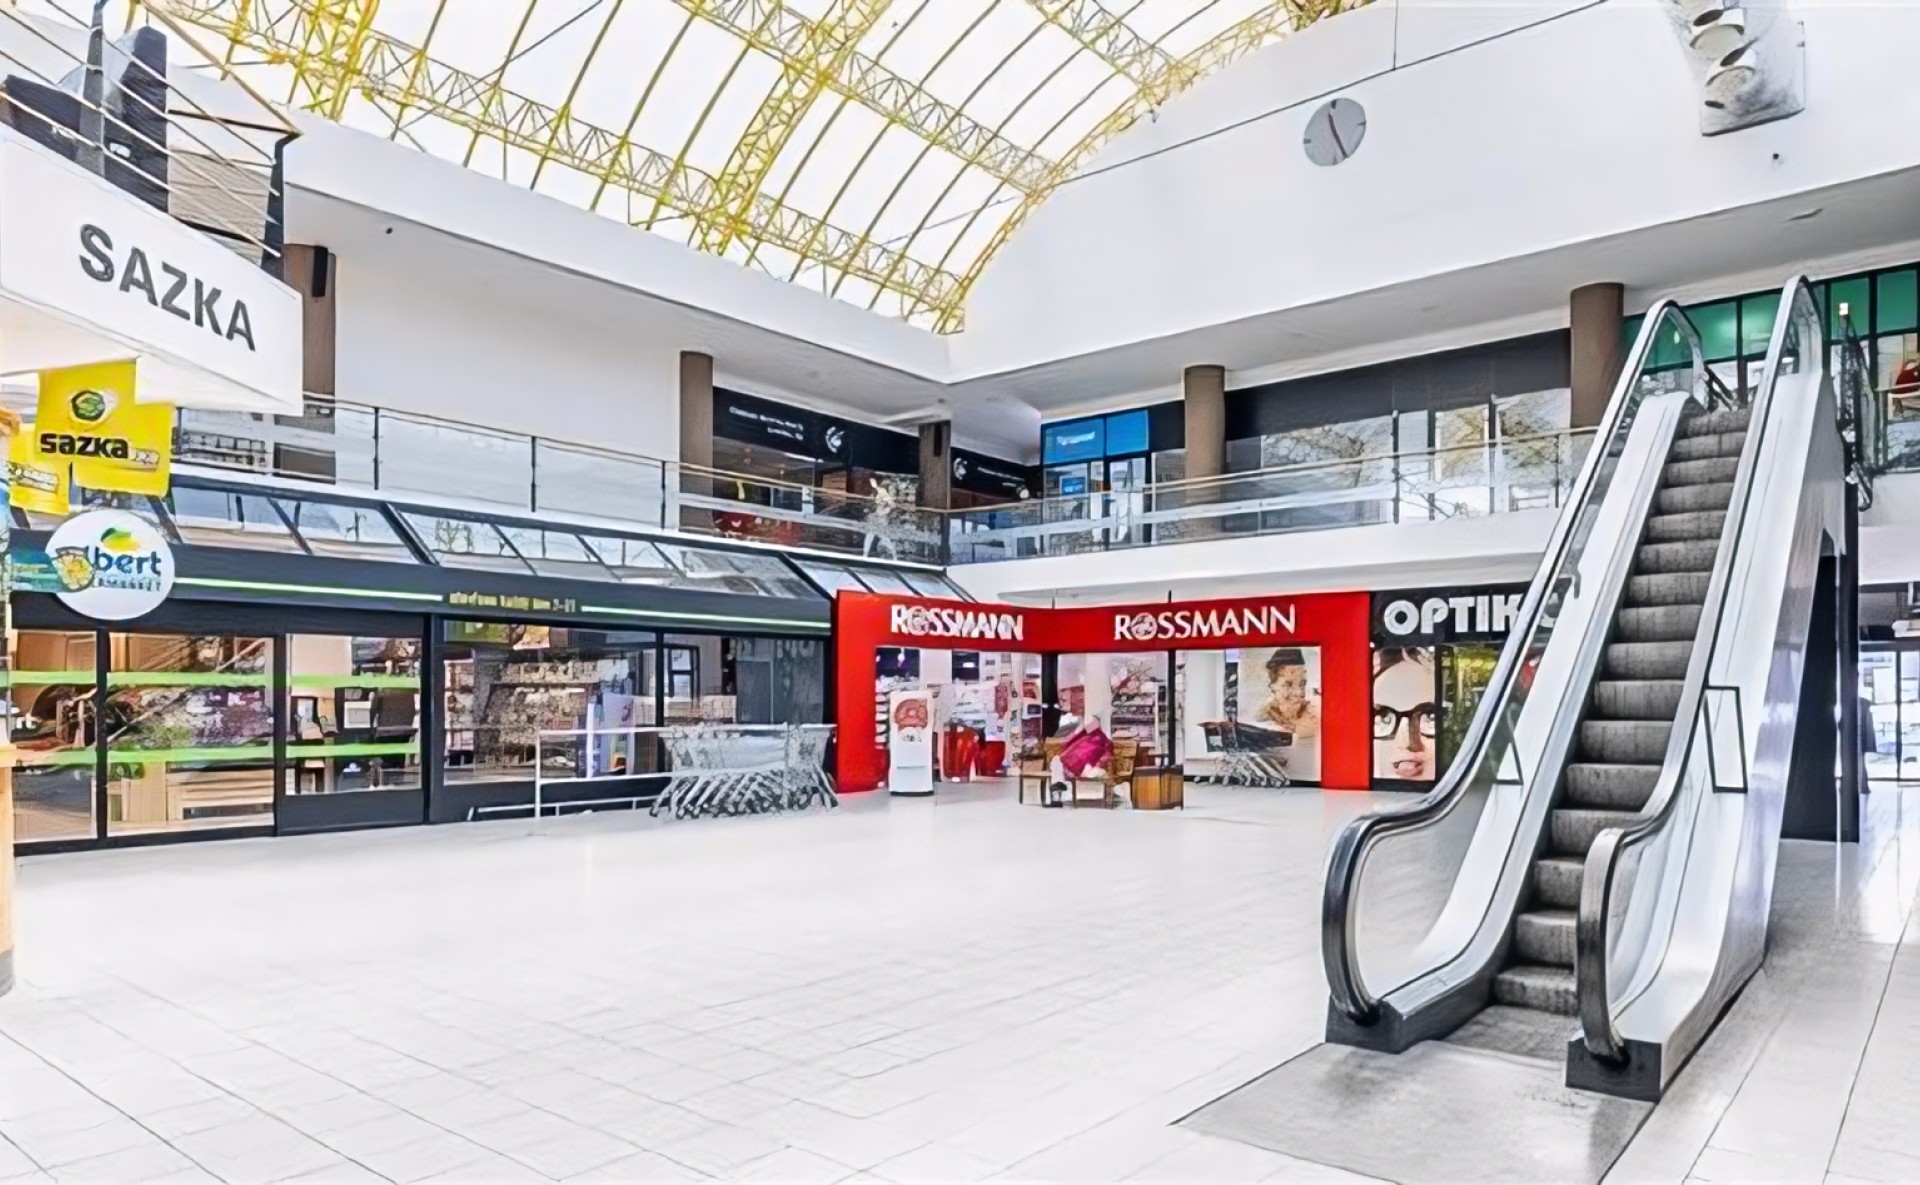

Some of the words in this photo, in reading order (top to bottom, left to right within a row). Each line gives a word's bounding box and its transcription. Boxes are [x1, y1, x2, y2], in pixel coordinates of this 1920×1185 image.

[79, 223, 256, 352] SAZKA
[40, 432, 129, 459] sazka
[86, 545, 161, 576] bert
[1114, 605, 1296, 641] ROSSMANN
[1384, 593, 1560, 634] OPTIK
